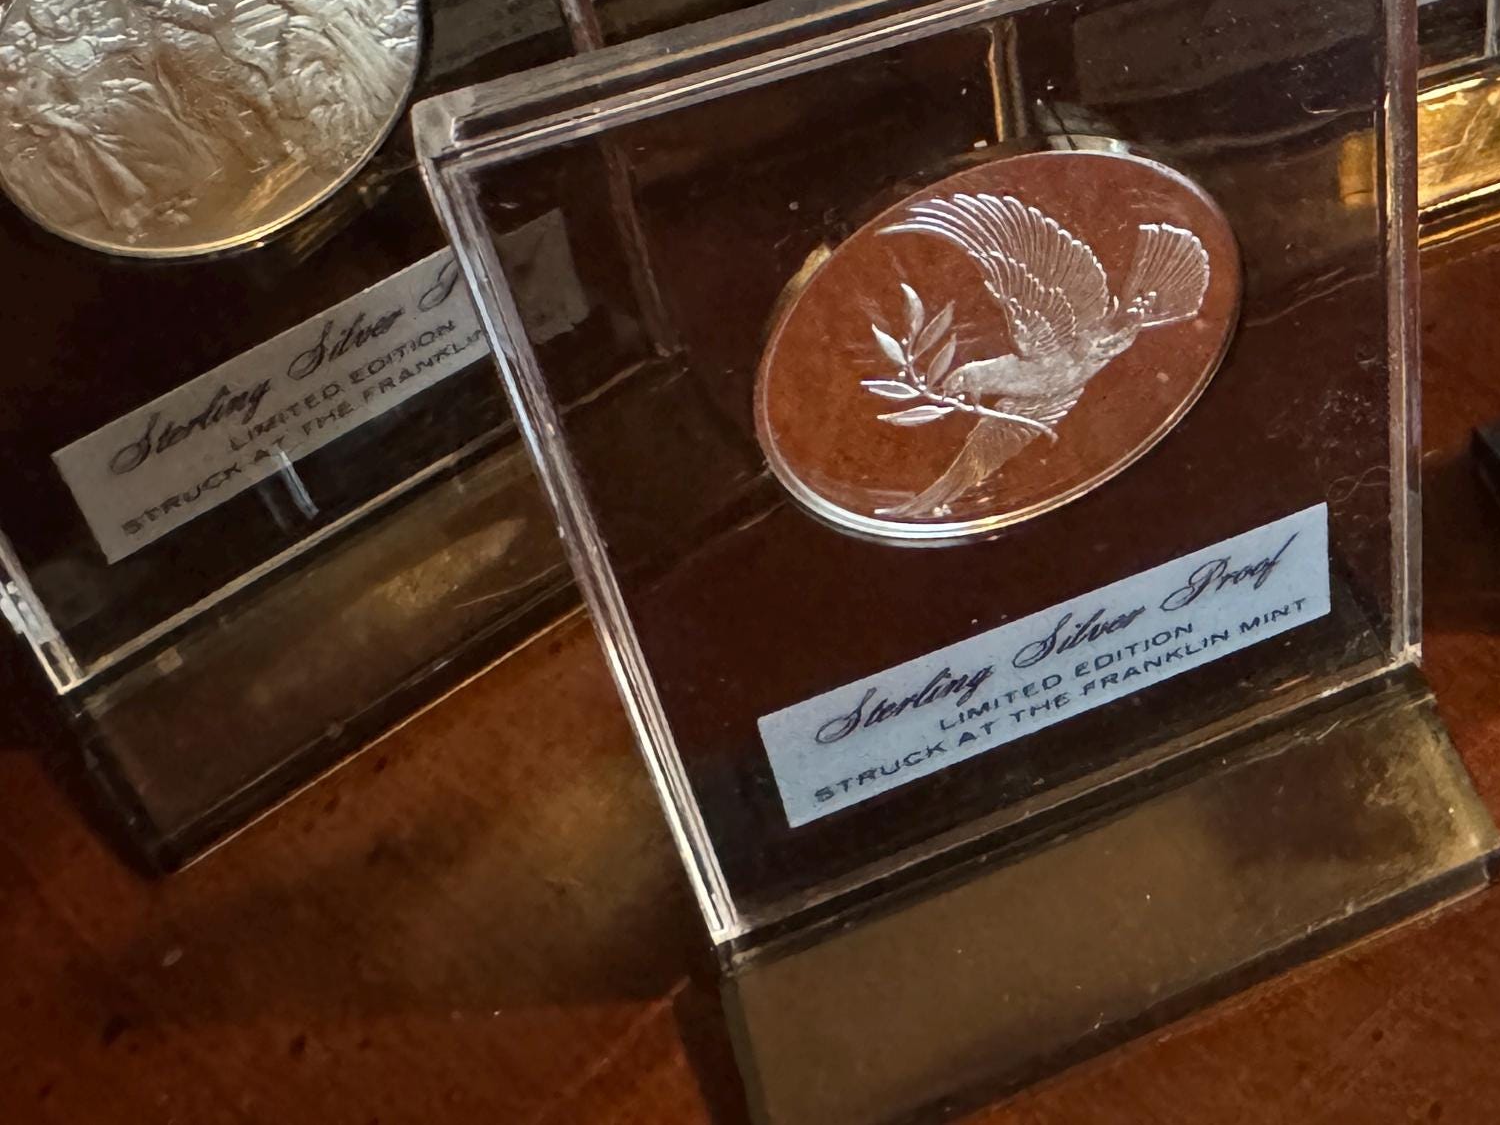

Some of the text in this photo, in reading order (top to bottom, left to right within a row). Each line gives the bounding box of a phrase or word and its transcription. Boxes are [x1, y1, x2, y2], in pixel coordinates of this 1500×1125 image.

[107, 306, 408, 475] Sterling Silver
[228, 318, 457, 453] LIMITED EDITION
[121, 461, 243, 538] STRUCK
[252, 433, 286, 463] AT
[300, 400, 356, 437] THE
[812, 595, 1309, 805] STRUCK AT THE FRANKLIN MINT
[813, 530, 1301, 746] Sterling Silver Proof
[938, 621, 1195, 732] LIMITED EDITION
